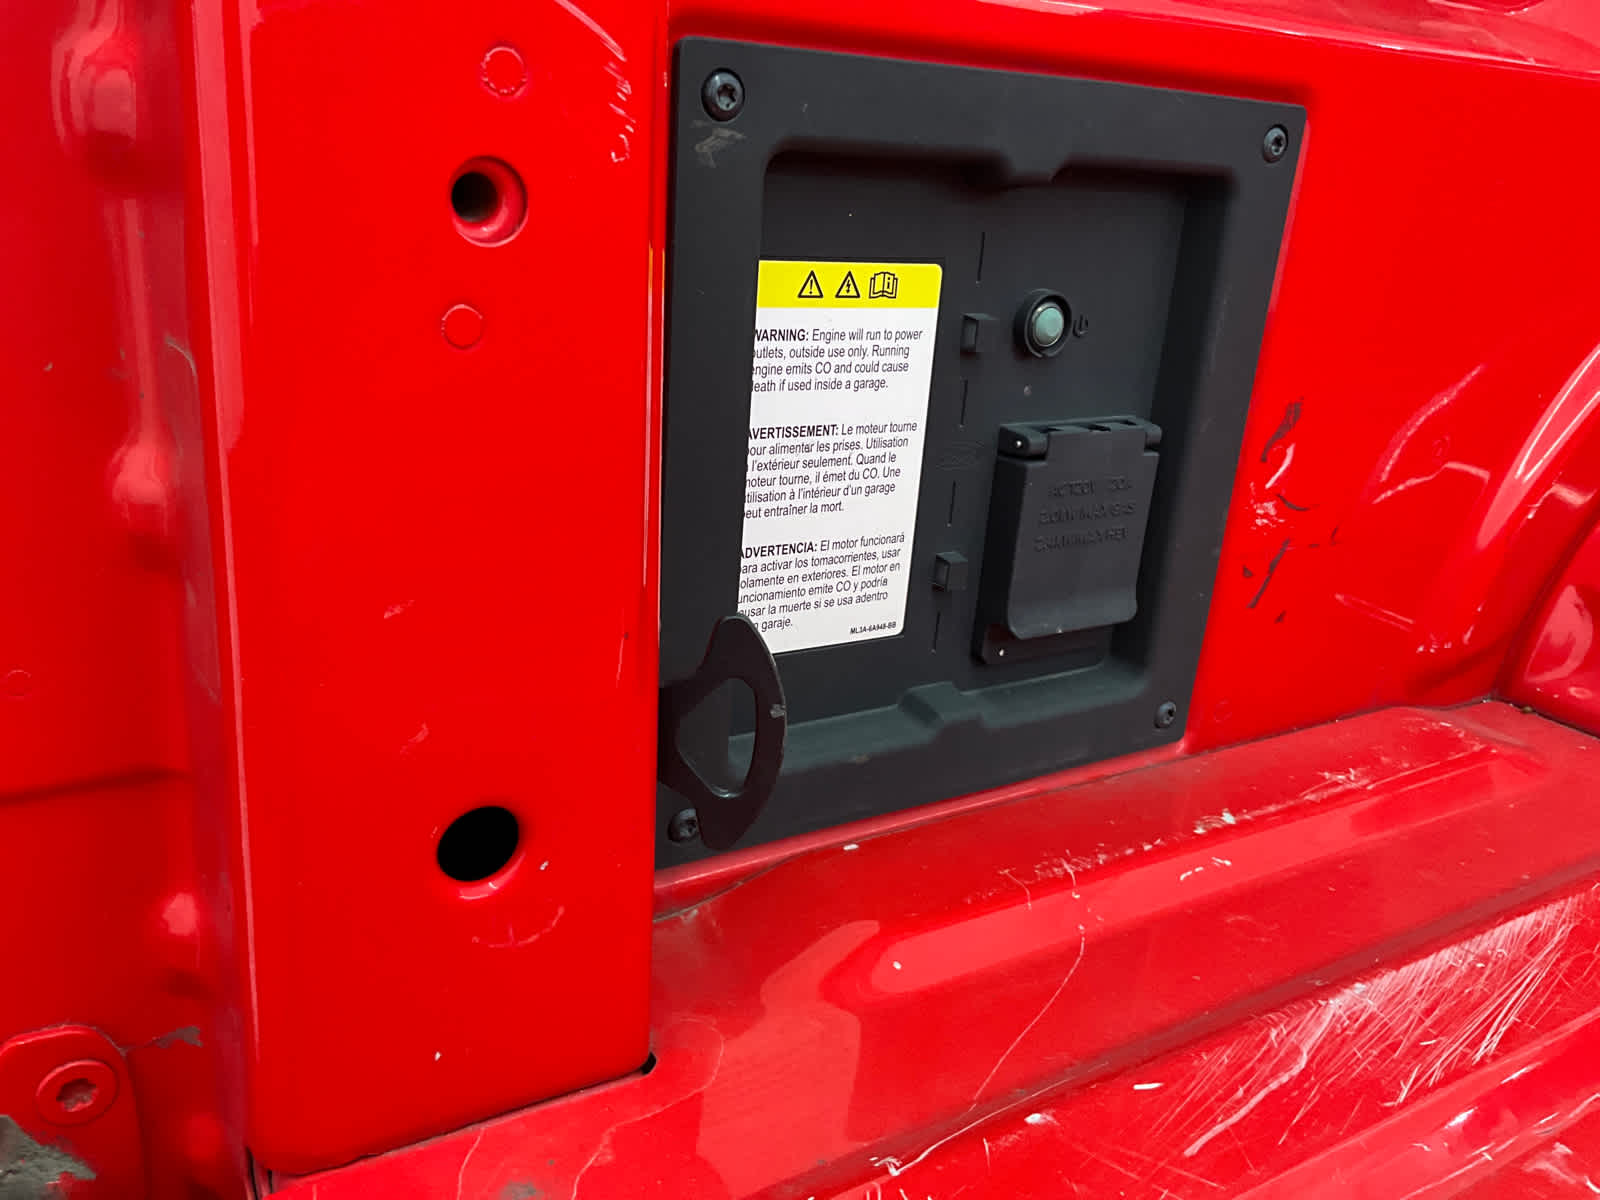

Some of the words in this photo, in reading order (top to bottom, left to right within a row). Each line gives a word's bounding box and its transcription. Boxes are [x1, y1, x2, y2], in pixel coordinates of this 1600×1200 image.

[812, 329, 845, 344] Engine
[849, 328, 863, 341] will
[866, 331, 881, 341] run
[884, 329, 892, 340] to
[894, 330, 923, 343] power
[789, 346, 825, 358] outside
[828, 348, 845, 358] use
[848, 345, 869, 360] only.
[872, 345, 910, 358] Running
[785, 363, 812, 375] emits
[815, 362, 831, 374] CO
[834, 362, 852, 374] and
[854, 362, 879, 373] could
[882, 363, 909, 372] cause
[779, 379, 786, 391] if
[787, 379, 811, 391] used
[814, 378, 842, 390] inside
[845, 380, 851, 389] a
[853, 378, 888, 392] garage.
[841, 423, 853, 436] Le
[856, 423, 887, 435] moteur
[889, 421, 918, 432] tourne
[748, 446, 765, 456] our
[769, 442, 813, 455] alimenter
[816, 440, 830, 453] les
[833, 439, 863, 454] prises.
[866, 436, 908, 449] Utilisation
[802, 456, 852, 469] seulement.
[856, 453, 886, 466] Quand
[889, 451, 897, 463] le
[779, 473, 812, 486] tourne,
[815, 471, 820, 483] il
[823, 469, 846, 483] émet
[848, 469, 860, 480] du
[863, 467, 879, 480] CO.
[882, 465, 901, 478] Une
[745, 490, 787, 504] tilisation
[789, 488, 795, 500] à
[864, 482, 896, 497] garage
[744, 506, 762, 519] eut
[809, 501, 818, 514] la
[821, 501, 843, 512] mort.
[820, 540, 830, 552] El
[832, 538, 859, 550] motor
[861, 533, 905, 547] funcionará
[741, 563, 758, 574] ara
[761, 559, 792, 572] activar
[795, 557, 808, 569] los
[811, 551, 879, 566] tomacorrientes,
[882, 549, 901, 559] usar
[740, 575, 785, 589] olamente
[787, 574, 799, 583] en
[802, 568, 848, 582] exteriores.
[852, 565, 860, 577] El
[863, 563, 887, 574] motor
[890, 562, 900, 571] en
[808, 583, 833, 596] emite
[836, 580, 851, 592] CO
[853, 581, 858, 592] y
[861, 577, 888, 590] podría
[768, 603, 776, 615] la
[779, 599, 811, 614] muerte
[814, 598, 821, 608] si
[823, 598, 835, 607] se
[837, 596, 853, 606] usa
[855, 591, 888, 604] adentro
[761, 617, 793, 633] garaje.
